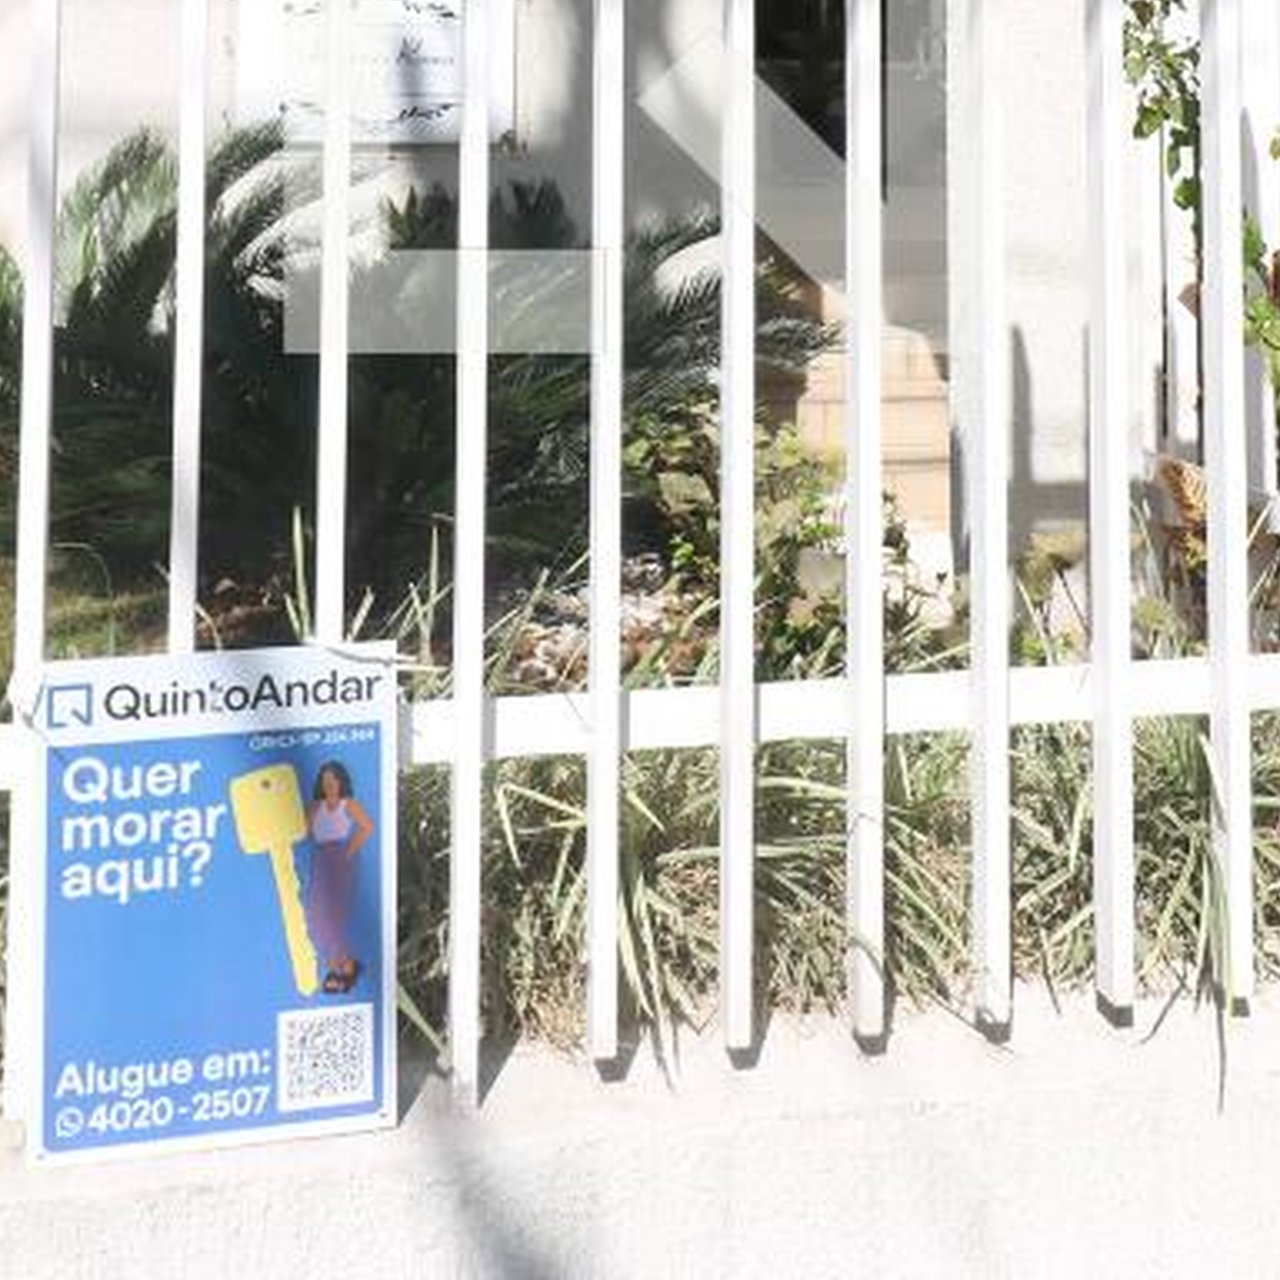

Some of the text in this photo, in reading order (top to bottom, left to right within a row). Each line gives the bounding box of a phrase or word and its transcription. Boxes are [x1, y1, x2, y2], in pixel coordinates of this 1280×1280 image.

[63, 757, 202, 803] Quer
[62, 803, 227, 851] morar
[62, 841, 212, 904] aqui?
[54, 1049, 270, 1098] Alugue em:
